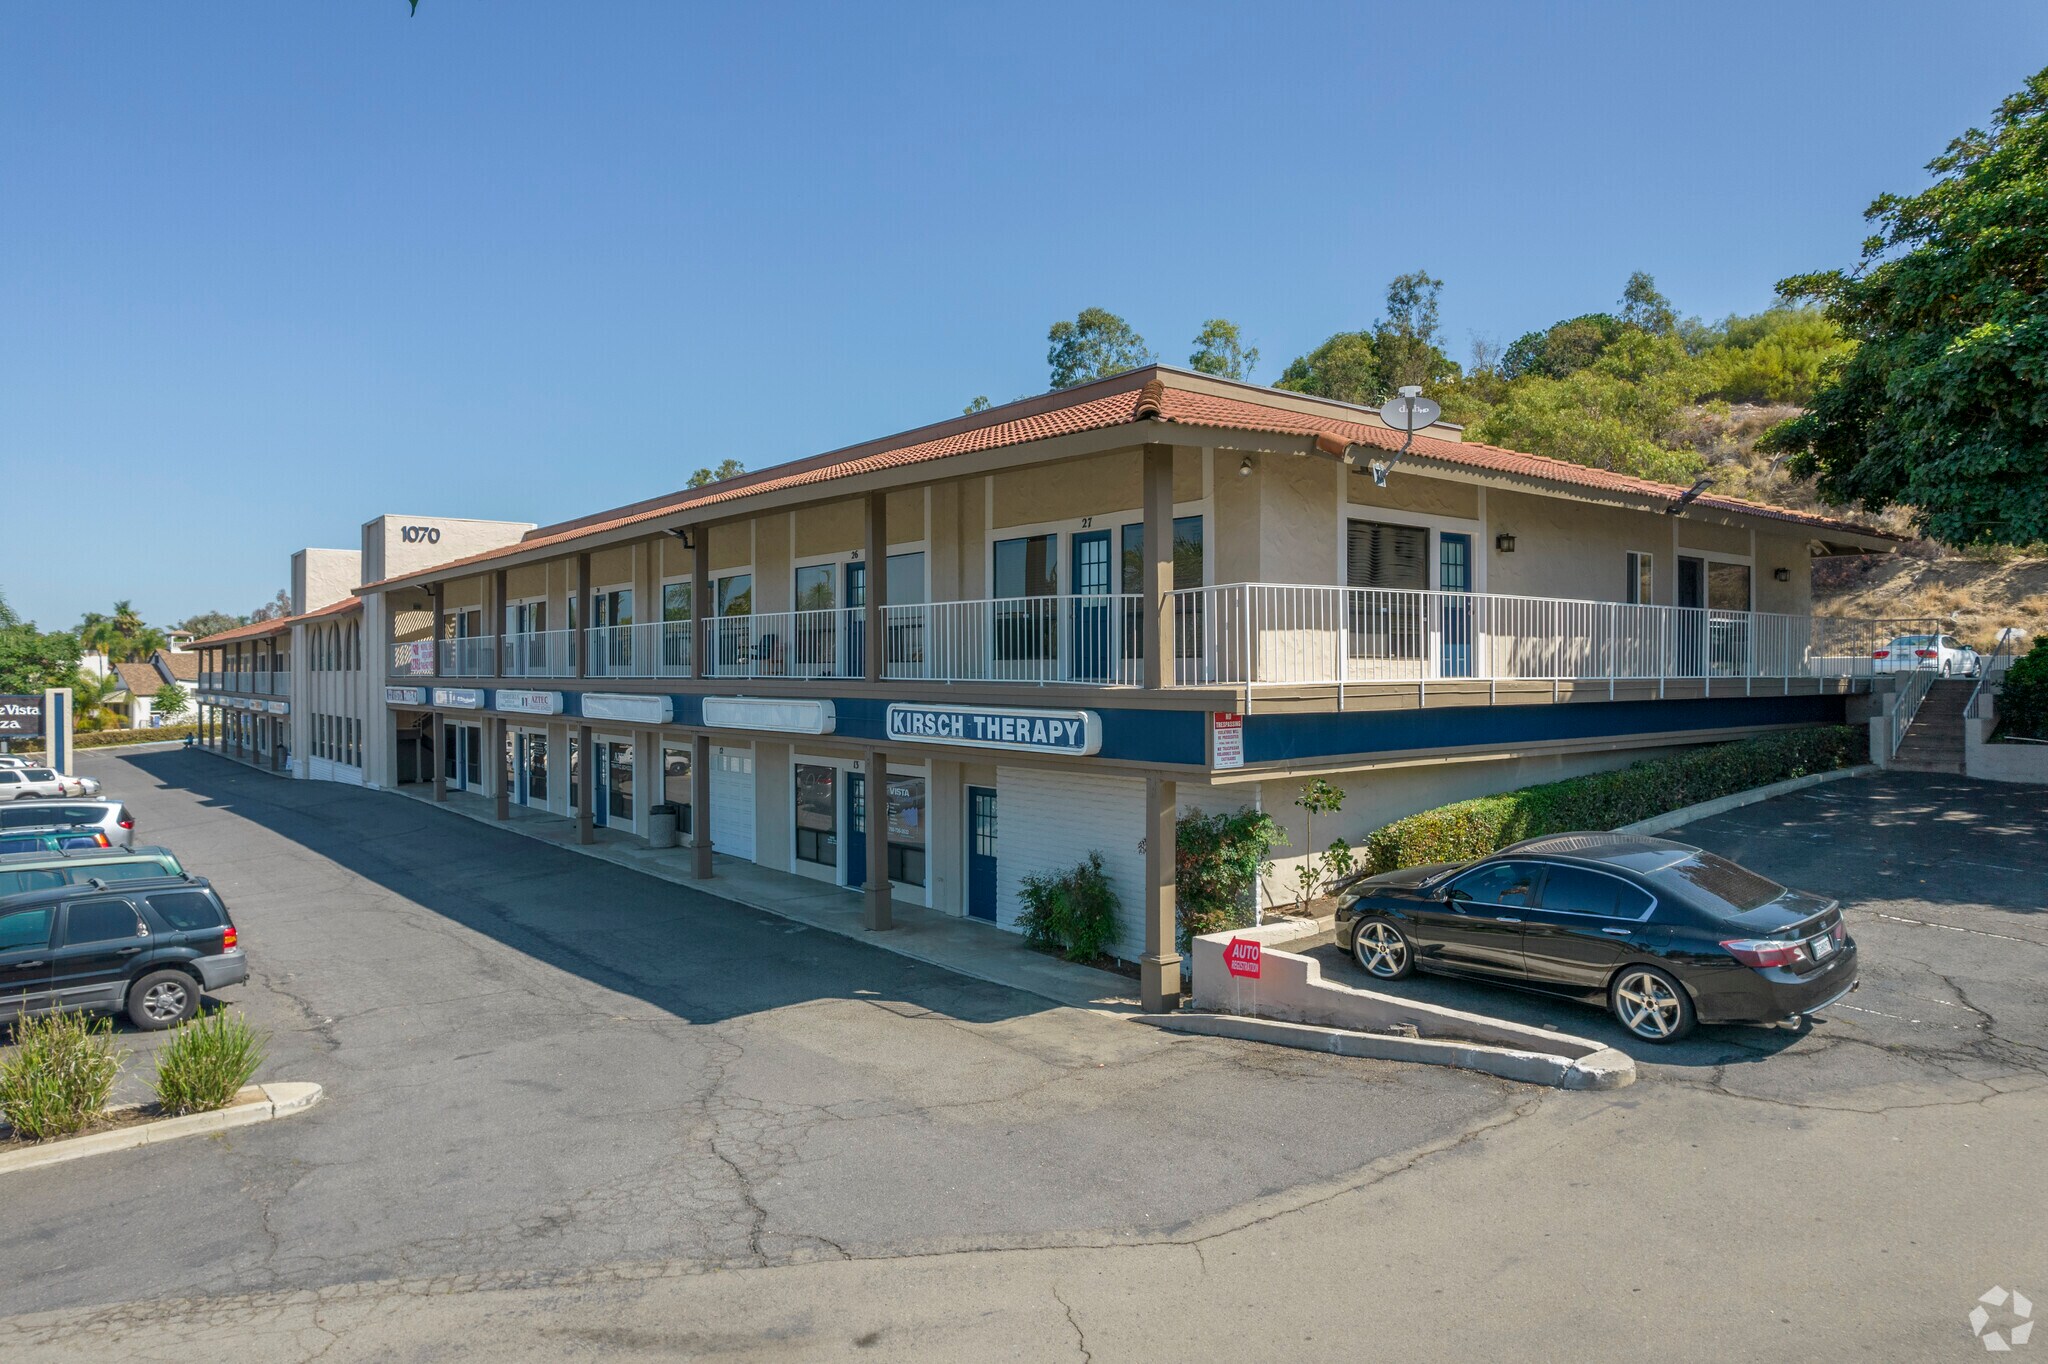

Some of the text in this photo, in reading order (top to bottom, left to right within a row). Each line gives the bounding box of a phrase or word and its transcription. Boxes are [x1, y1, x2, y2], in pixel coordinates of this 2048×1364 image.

[1081, 517, 1093, 529] 27
[401, 526, 440, 544] 1070
[893, 711, 1080, 745] KIRSCH THERAPY
[889, 787, 910, 797] VISTA
[1232, 943, 1259, 960] AUTO
